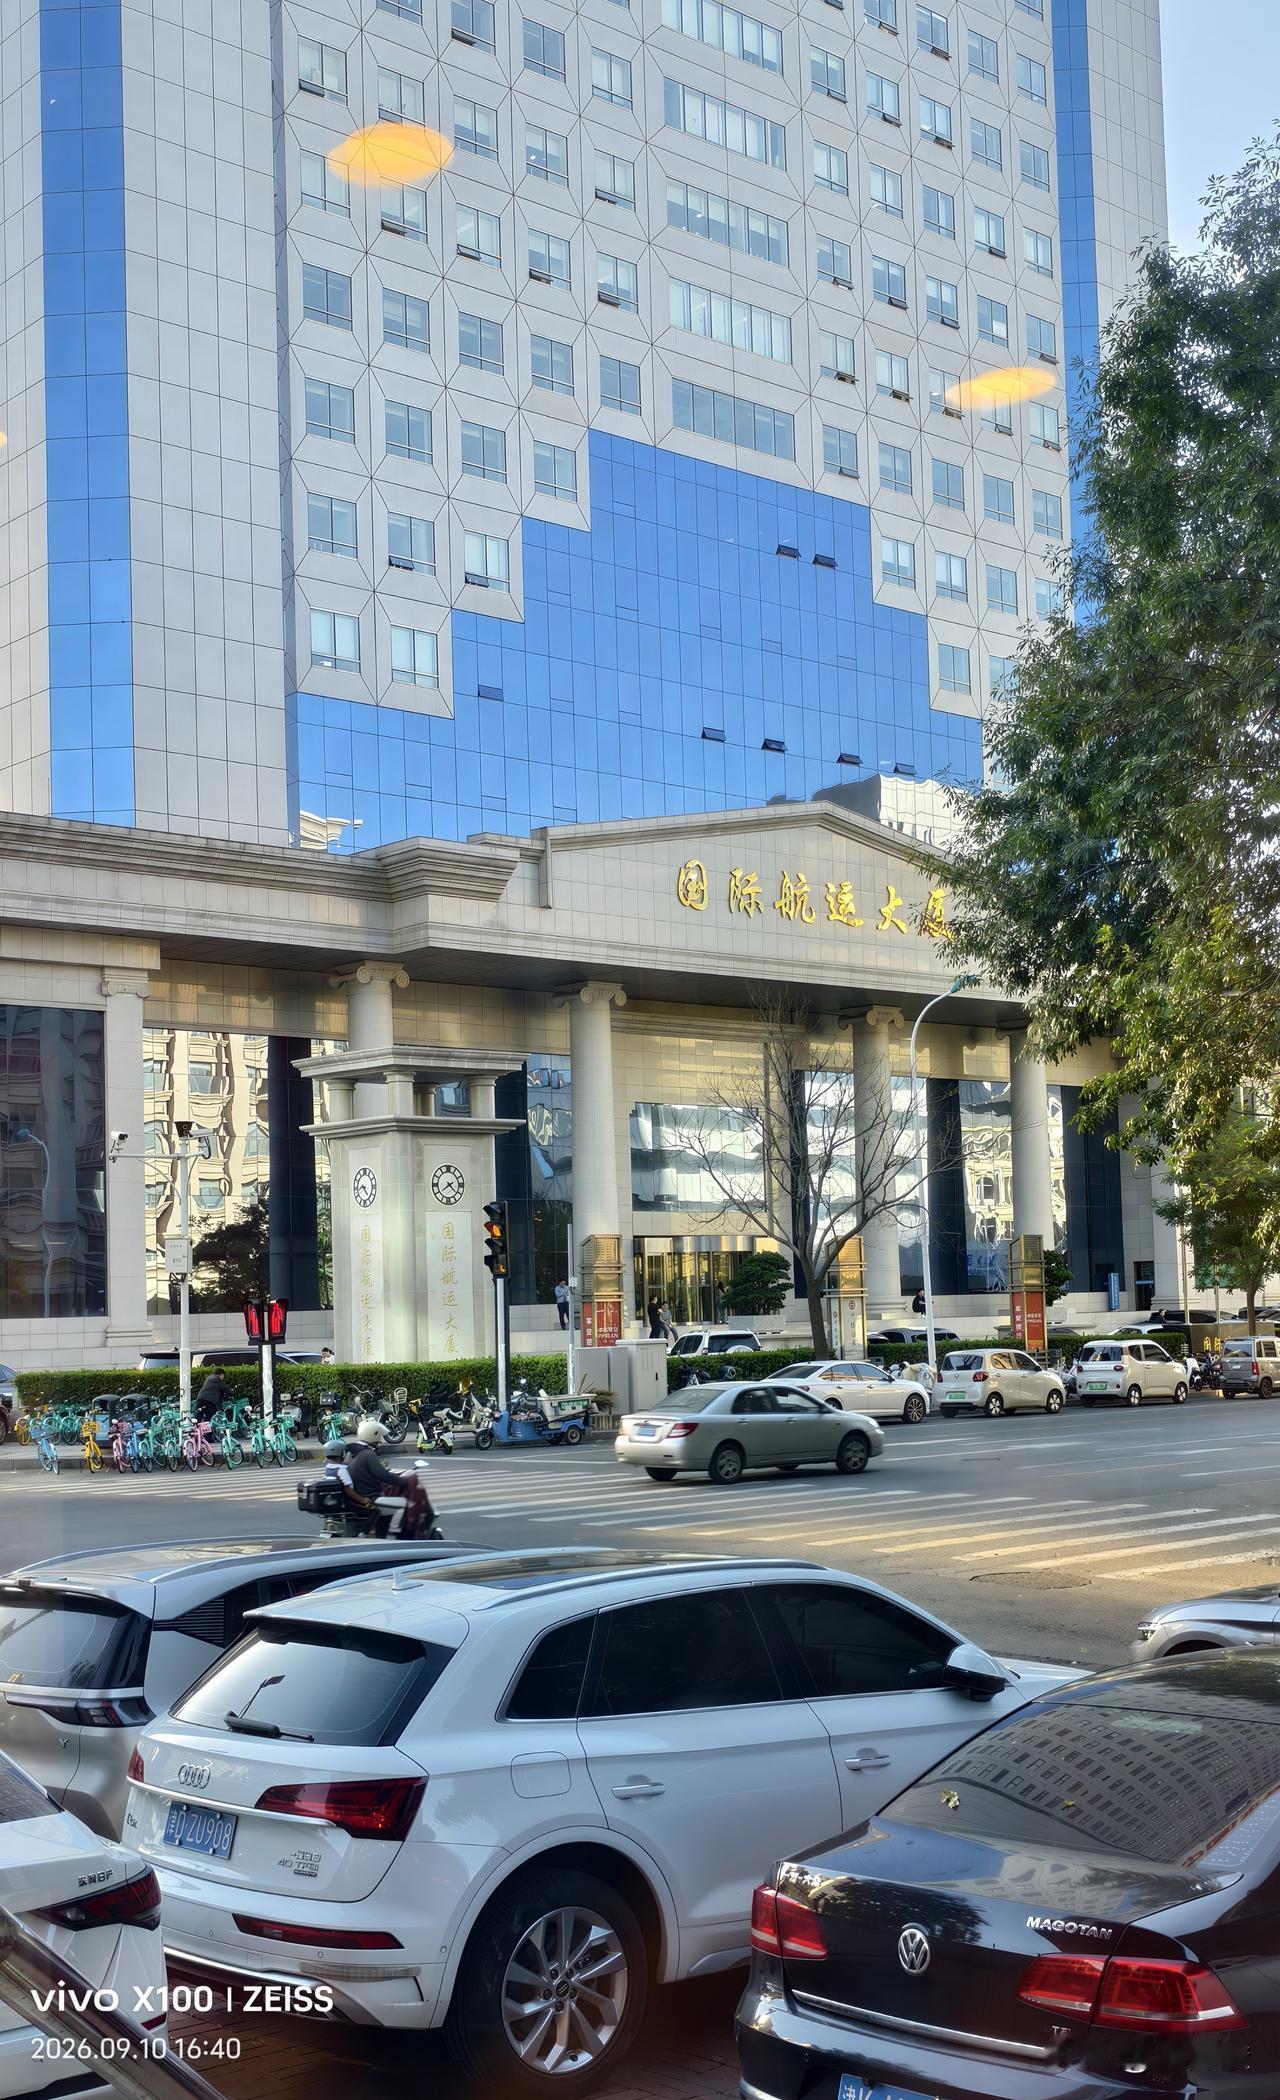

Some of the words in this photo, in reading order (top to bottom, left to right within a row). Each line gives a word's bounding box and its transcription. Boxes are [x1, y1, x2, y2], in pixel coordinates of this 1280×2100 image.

[676, 858, 955, 941] 国际航运大厦
[441, 1221, 459, 1354] 国际航运大厦
[277, 1858, 293, 1868] 40
[1026, 1915, 1113, 1940] MAGOTAN
